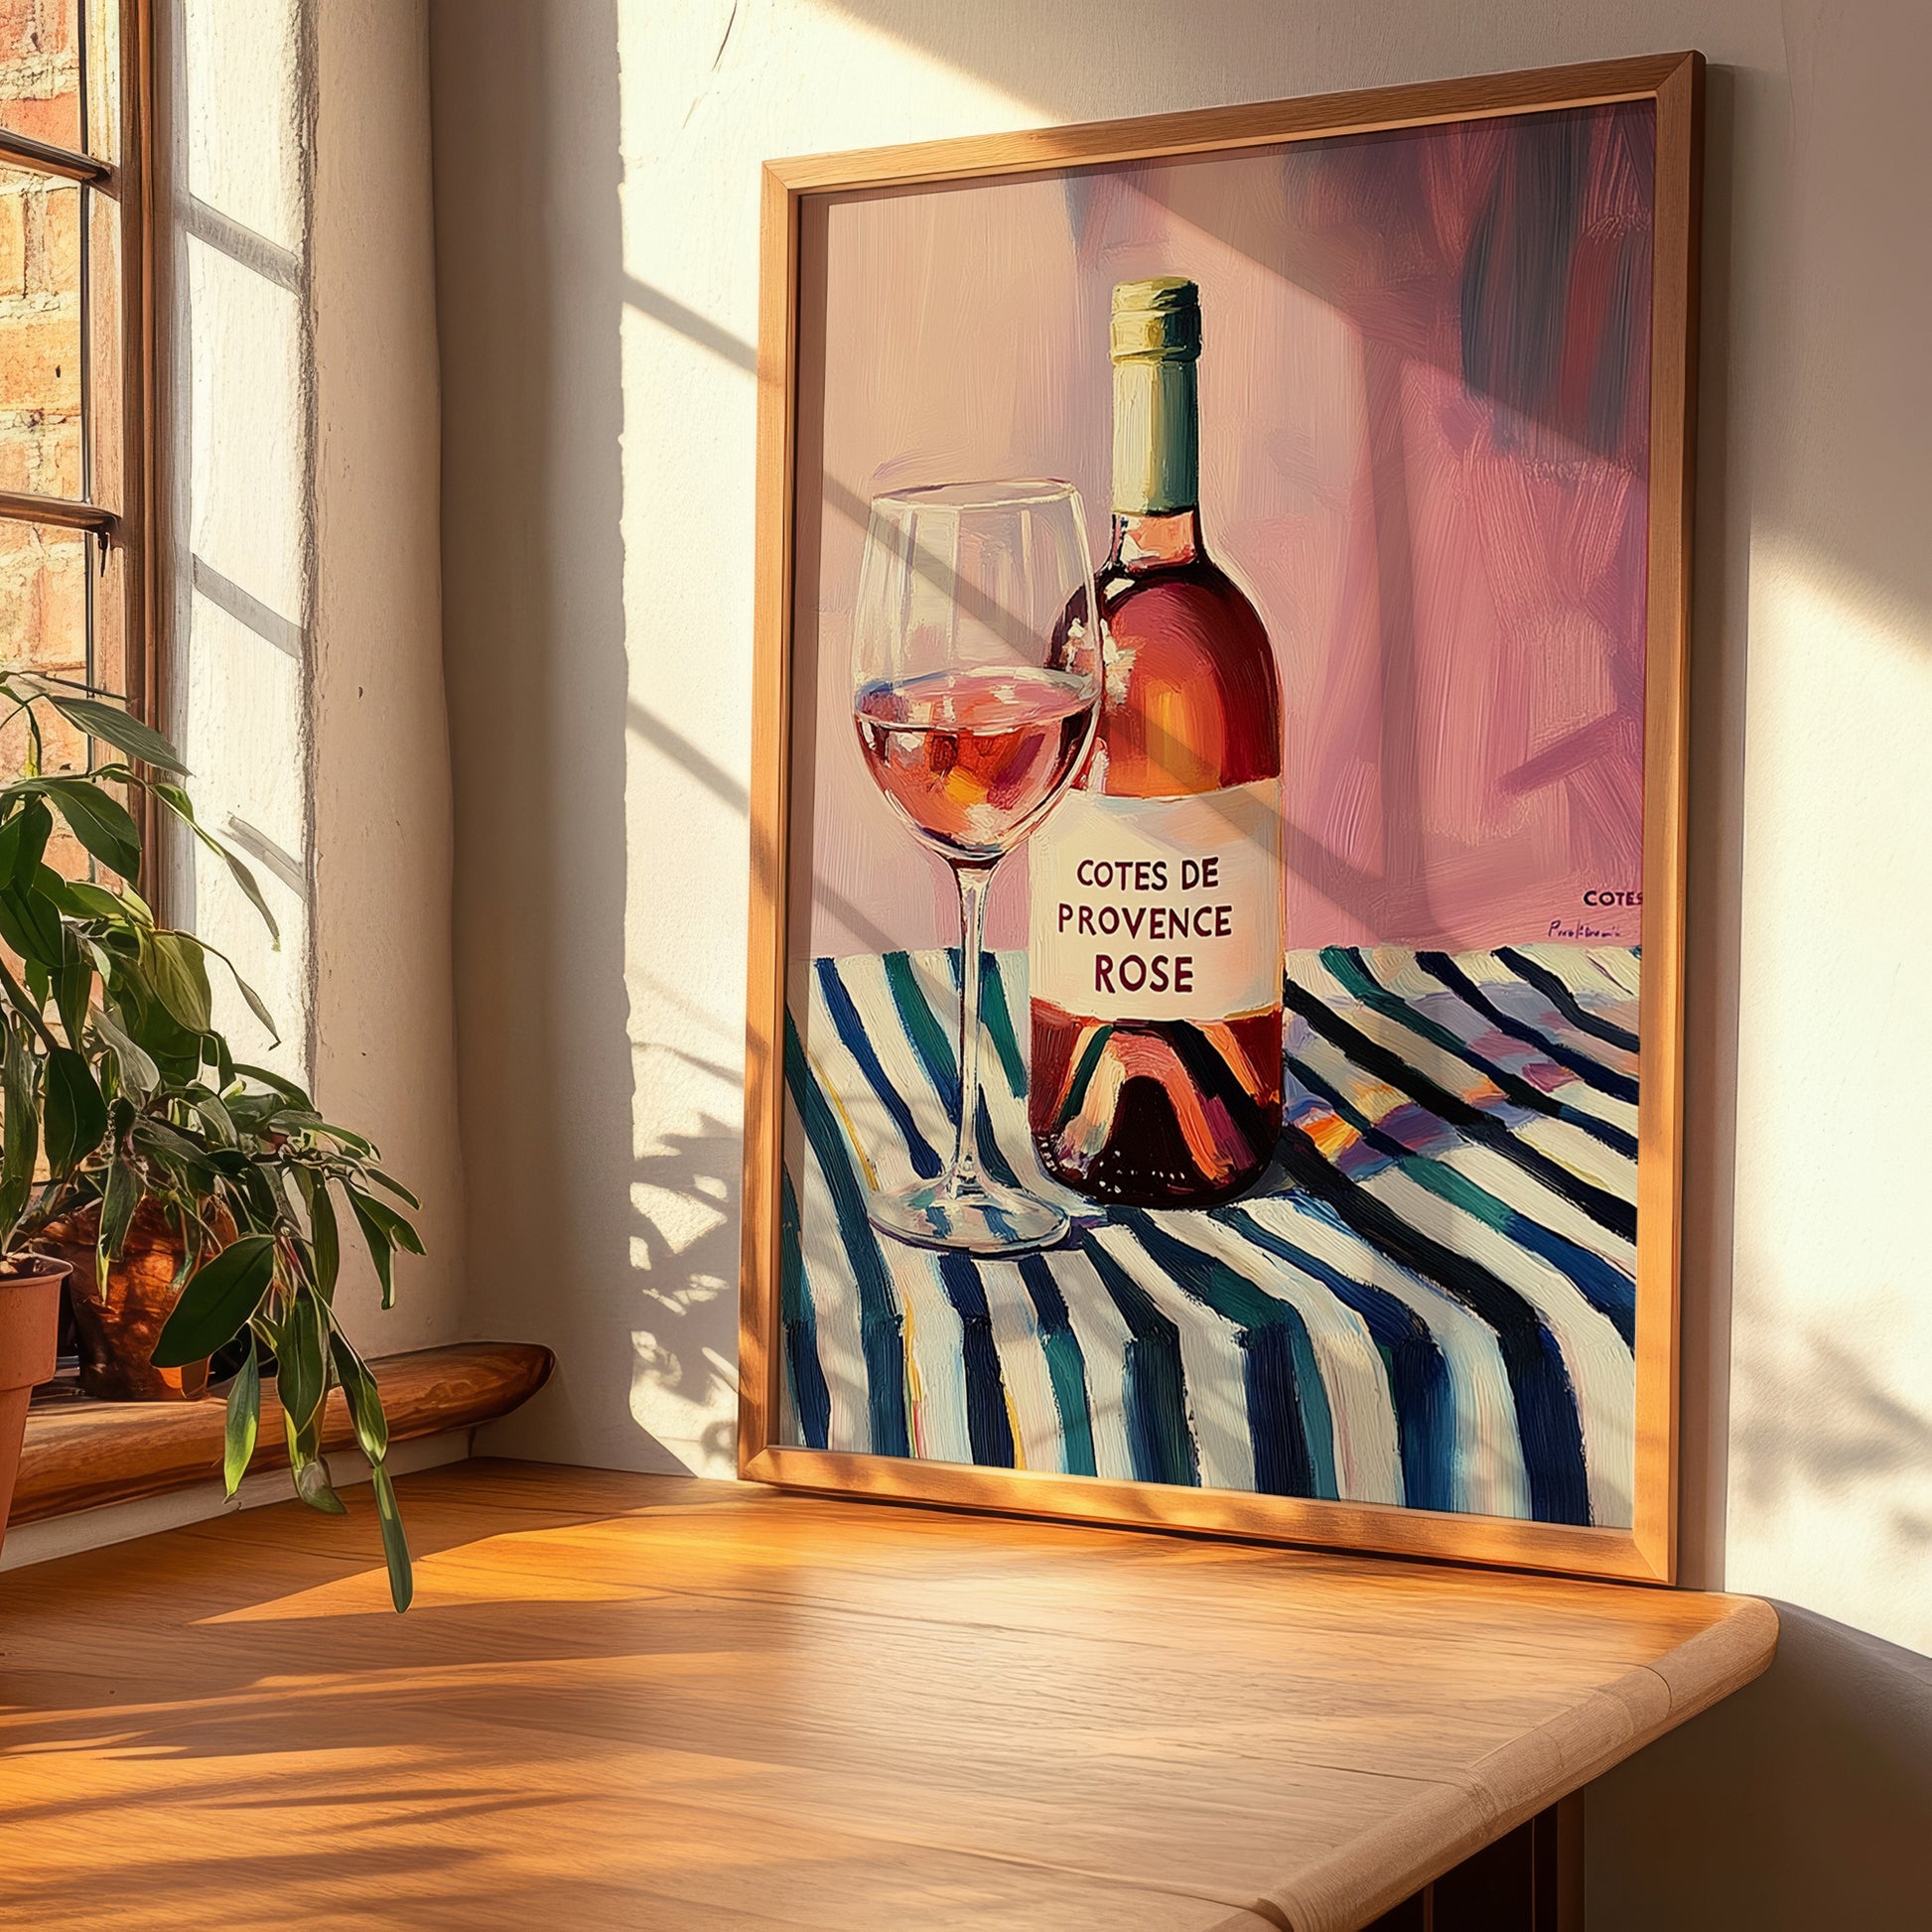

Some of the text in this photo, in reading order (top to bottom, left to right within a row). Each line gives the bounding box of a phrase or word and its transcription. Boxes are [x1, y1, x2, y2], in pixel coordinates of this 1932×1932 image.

[1077, 857, 1219, 891] COTES DE
[1058, 902, 1233, 939] PROVENCE
[1095, 954, 1193, 994] ROSE
